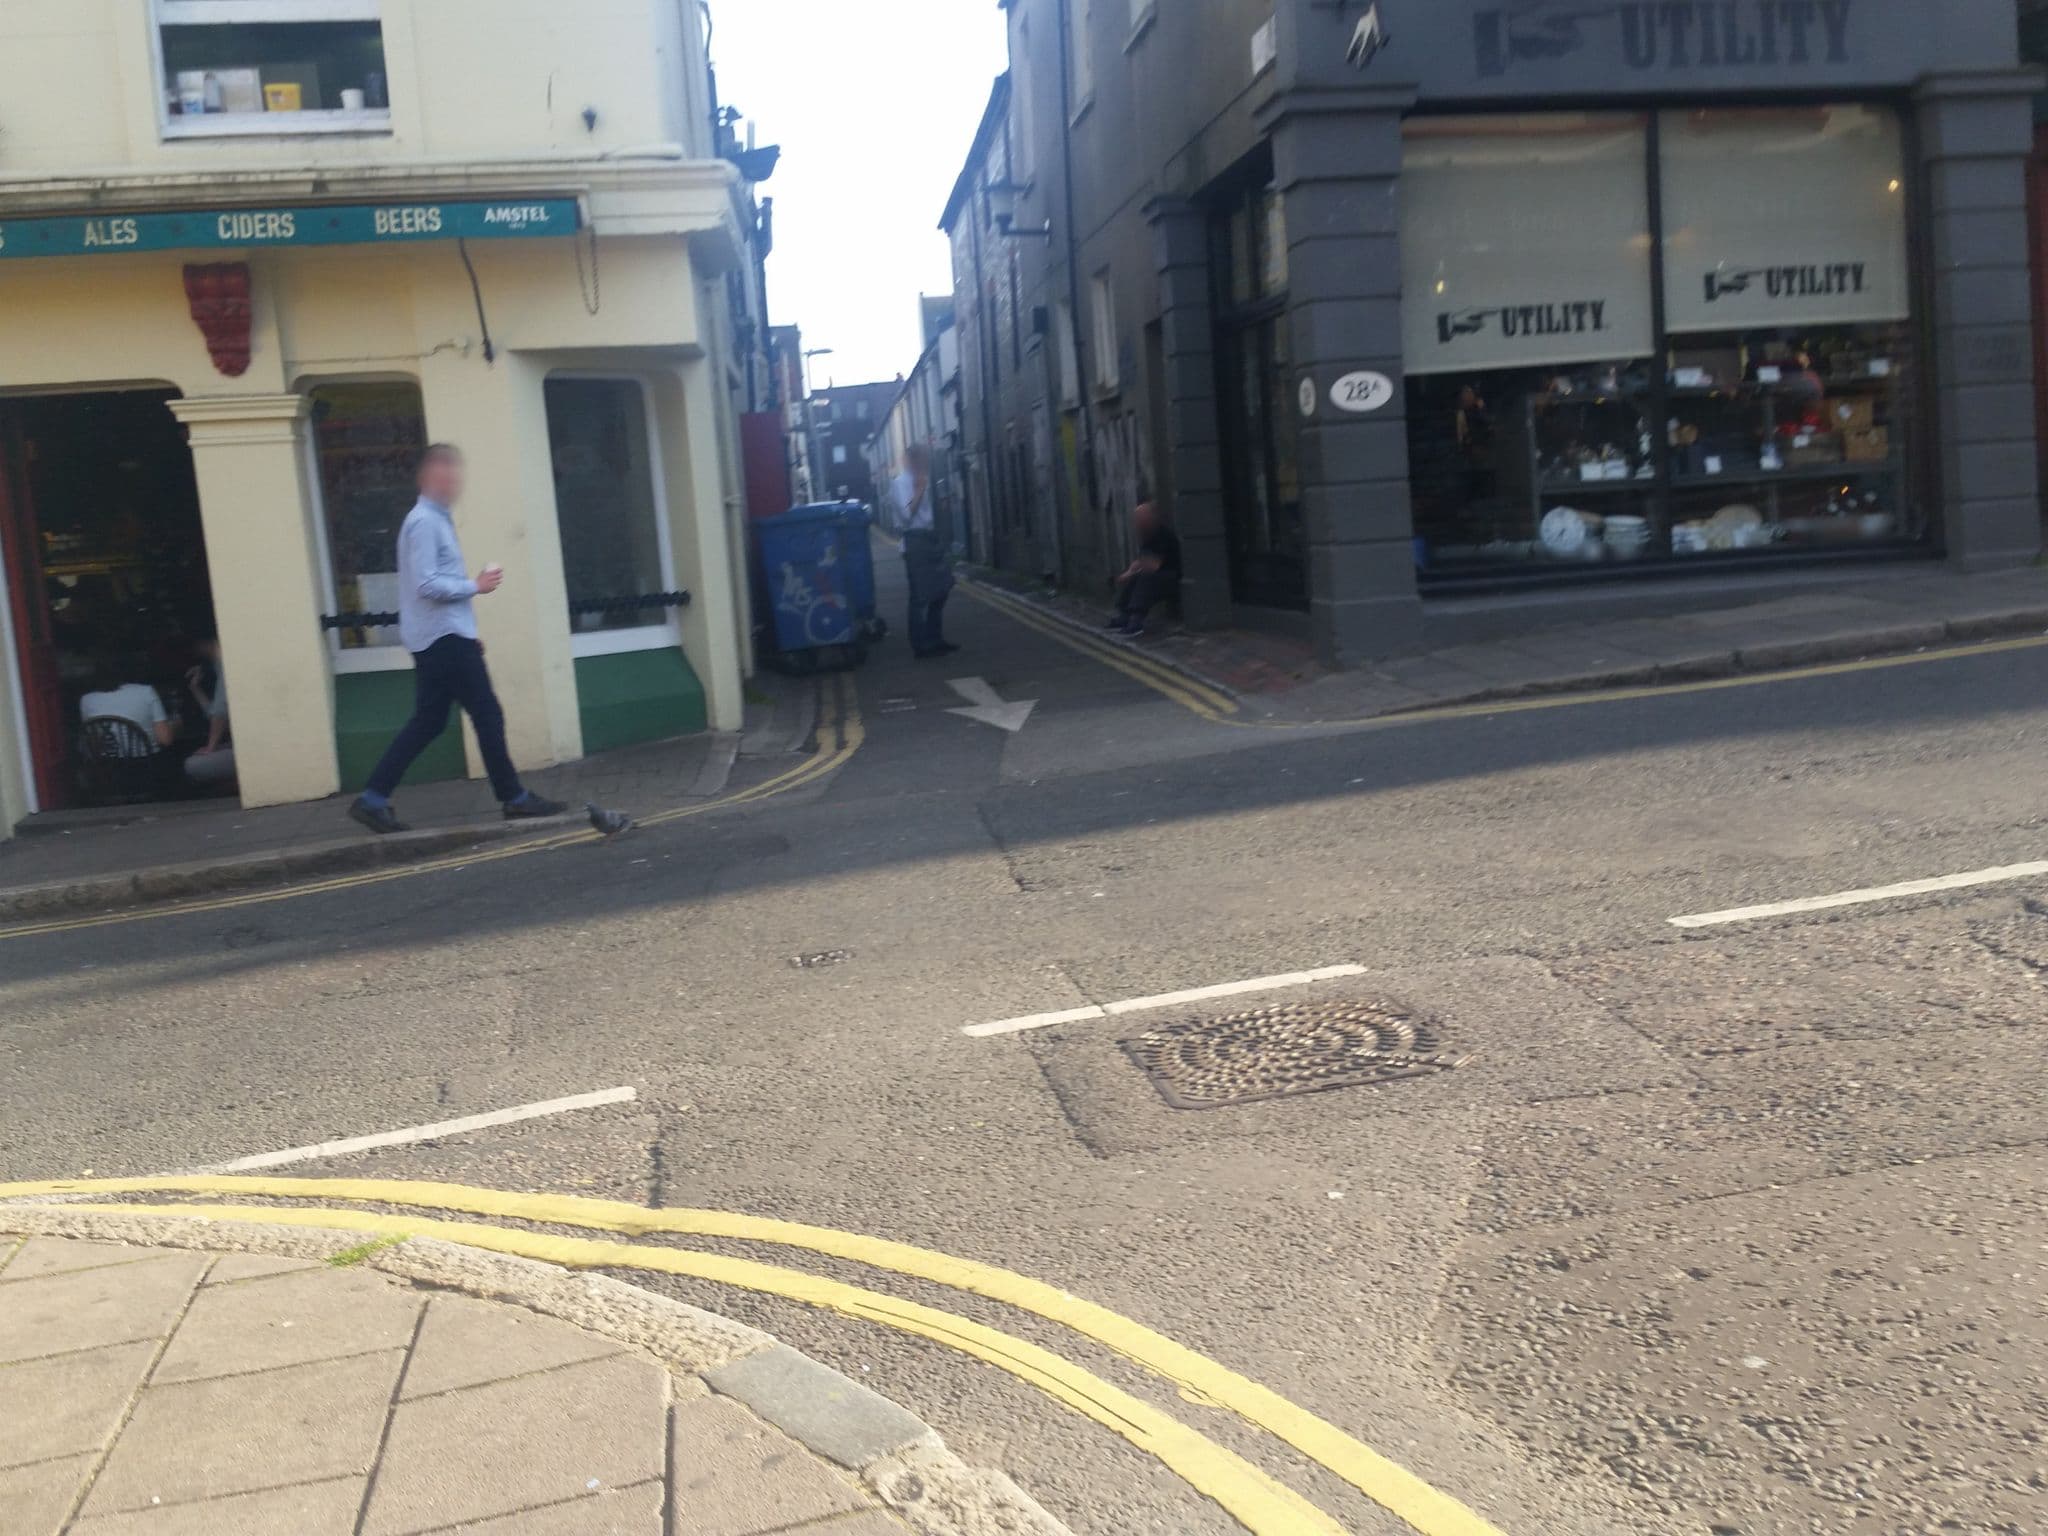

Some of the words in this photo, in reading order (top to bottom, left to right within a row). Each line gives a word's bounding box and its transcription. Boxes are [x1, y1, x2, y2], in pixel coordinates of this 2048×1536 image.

[1623, 0, 1850, 68] UTILITY
[84, 219, 138, 247] ALES
[218, 213, 296, 240] CIDERS
[375, 207, 442, 234] BEERS
[483, 206, 550, 224] AMSTEL
[1766, 263, 1864, 298] UTILITY
[1502, 301, 1605, 337] UTILITY
